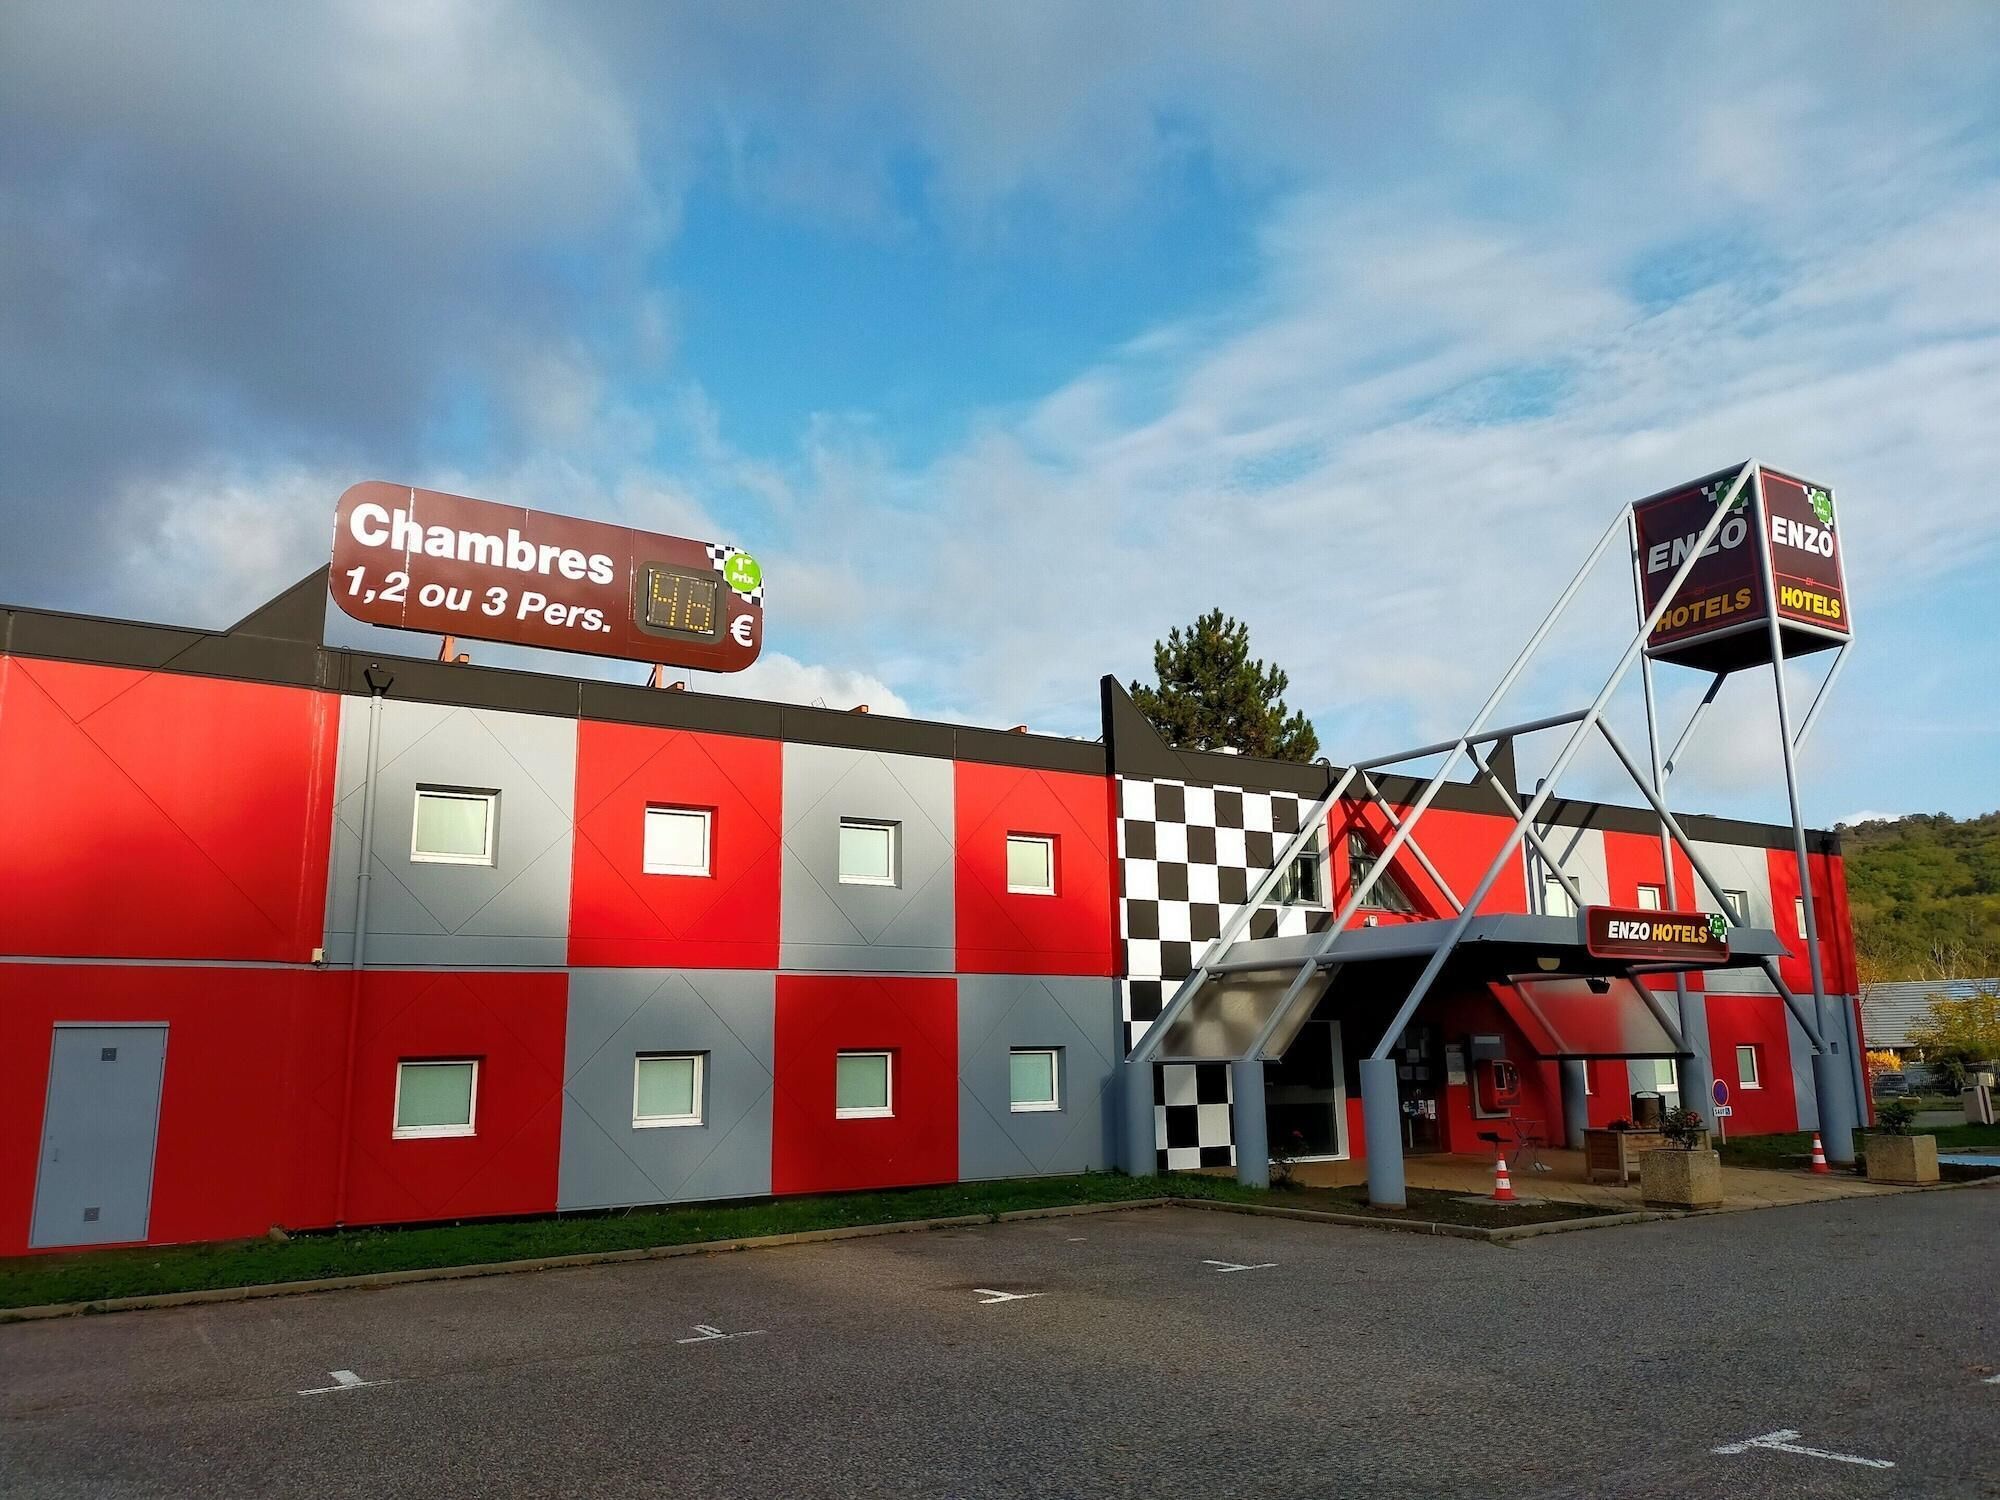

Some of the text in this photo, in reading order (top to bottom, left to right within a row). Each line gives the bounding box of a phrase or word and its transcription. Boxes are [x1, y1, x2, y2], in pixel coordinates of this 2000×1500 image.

[349, 502, 615, 585] Chambres
[1771, 514, 1834, 558] ENZO
[345, 565, 612, 633] 1,2 ou 3 Pers.
[1655, 587, 1752, 633] HOTELS
[1780, 585, 1841, 619] HOTELS
[729, 613, 755, 648] €
[1607, 920, 1651, 941] ENZO
[1652, 923, 1708, 944] HOTELS
